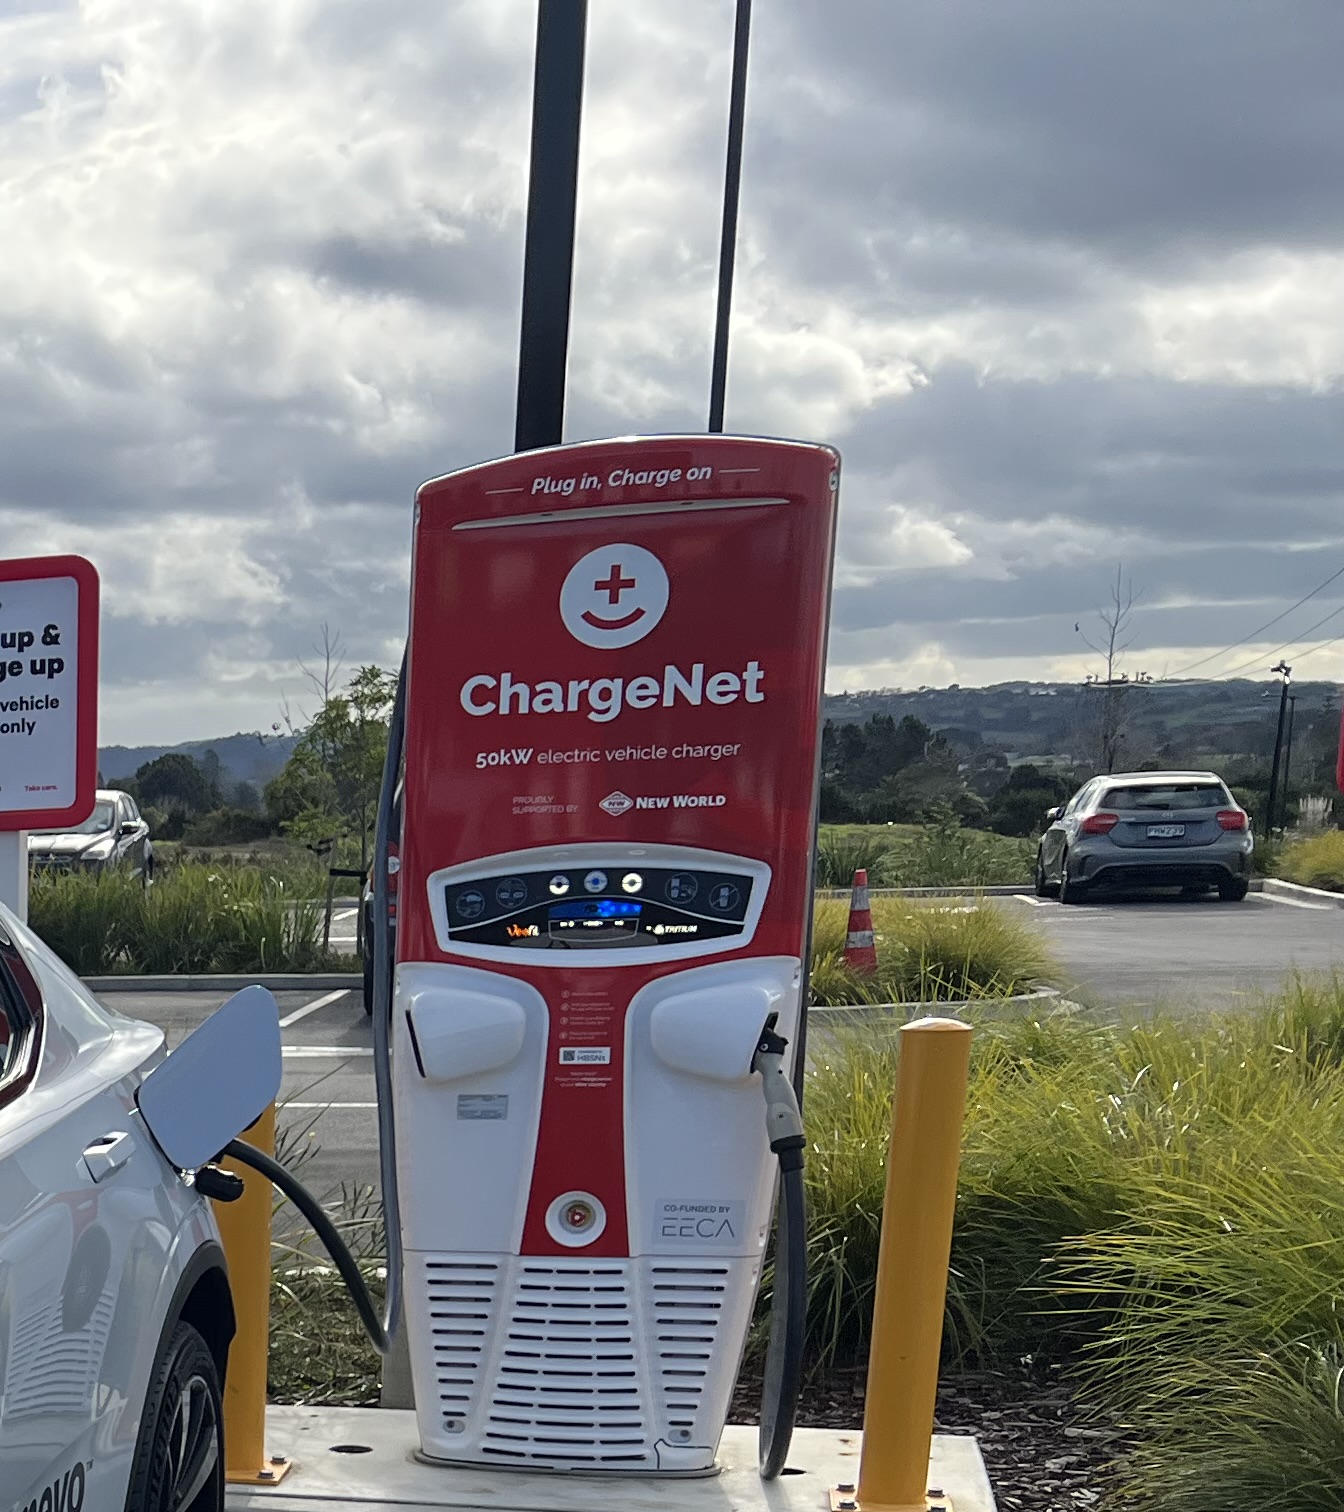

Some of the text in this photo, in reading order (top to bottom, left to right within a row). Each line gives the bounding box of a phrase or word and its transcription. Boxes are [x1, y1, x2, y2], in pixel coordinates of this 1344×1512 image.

[531, 466, 711, 495] Plug in, Charge on
[0, 630, 34, 652] up
[41, 624, 61, 645] &
[30, 657, 64, 679] up
[0, 694, 60, 711] vehicle
[460, 661, 765, 722] ChargeNet
[0, 718, 36, 735] only
[476, 742, 741, 768] 50kW electric vehicle charger
[636, 797, 670, 809] NEW
[673, 795, 727, 808] WORLD
